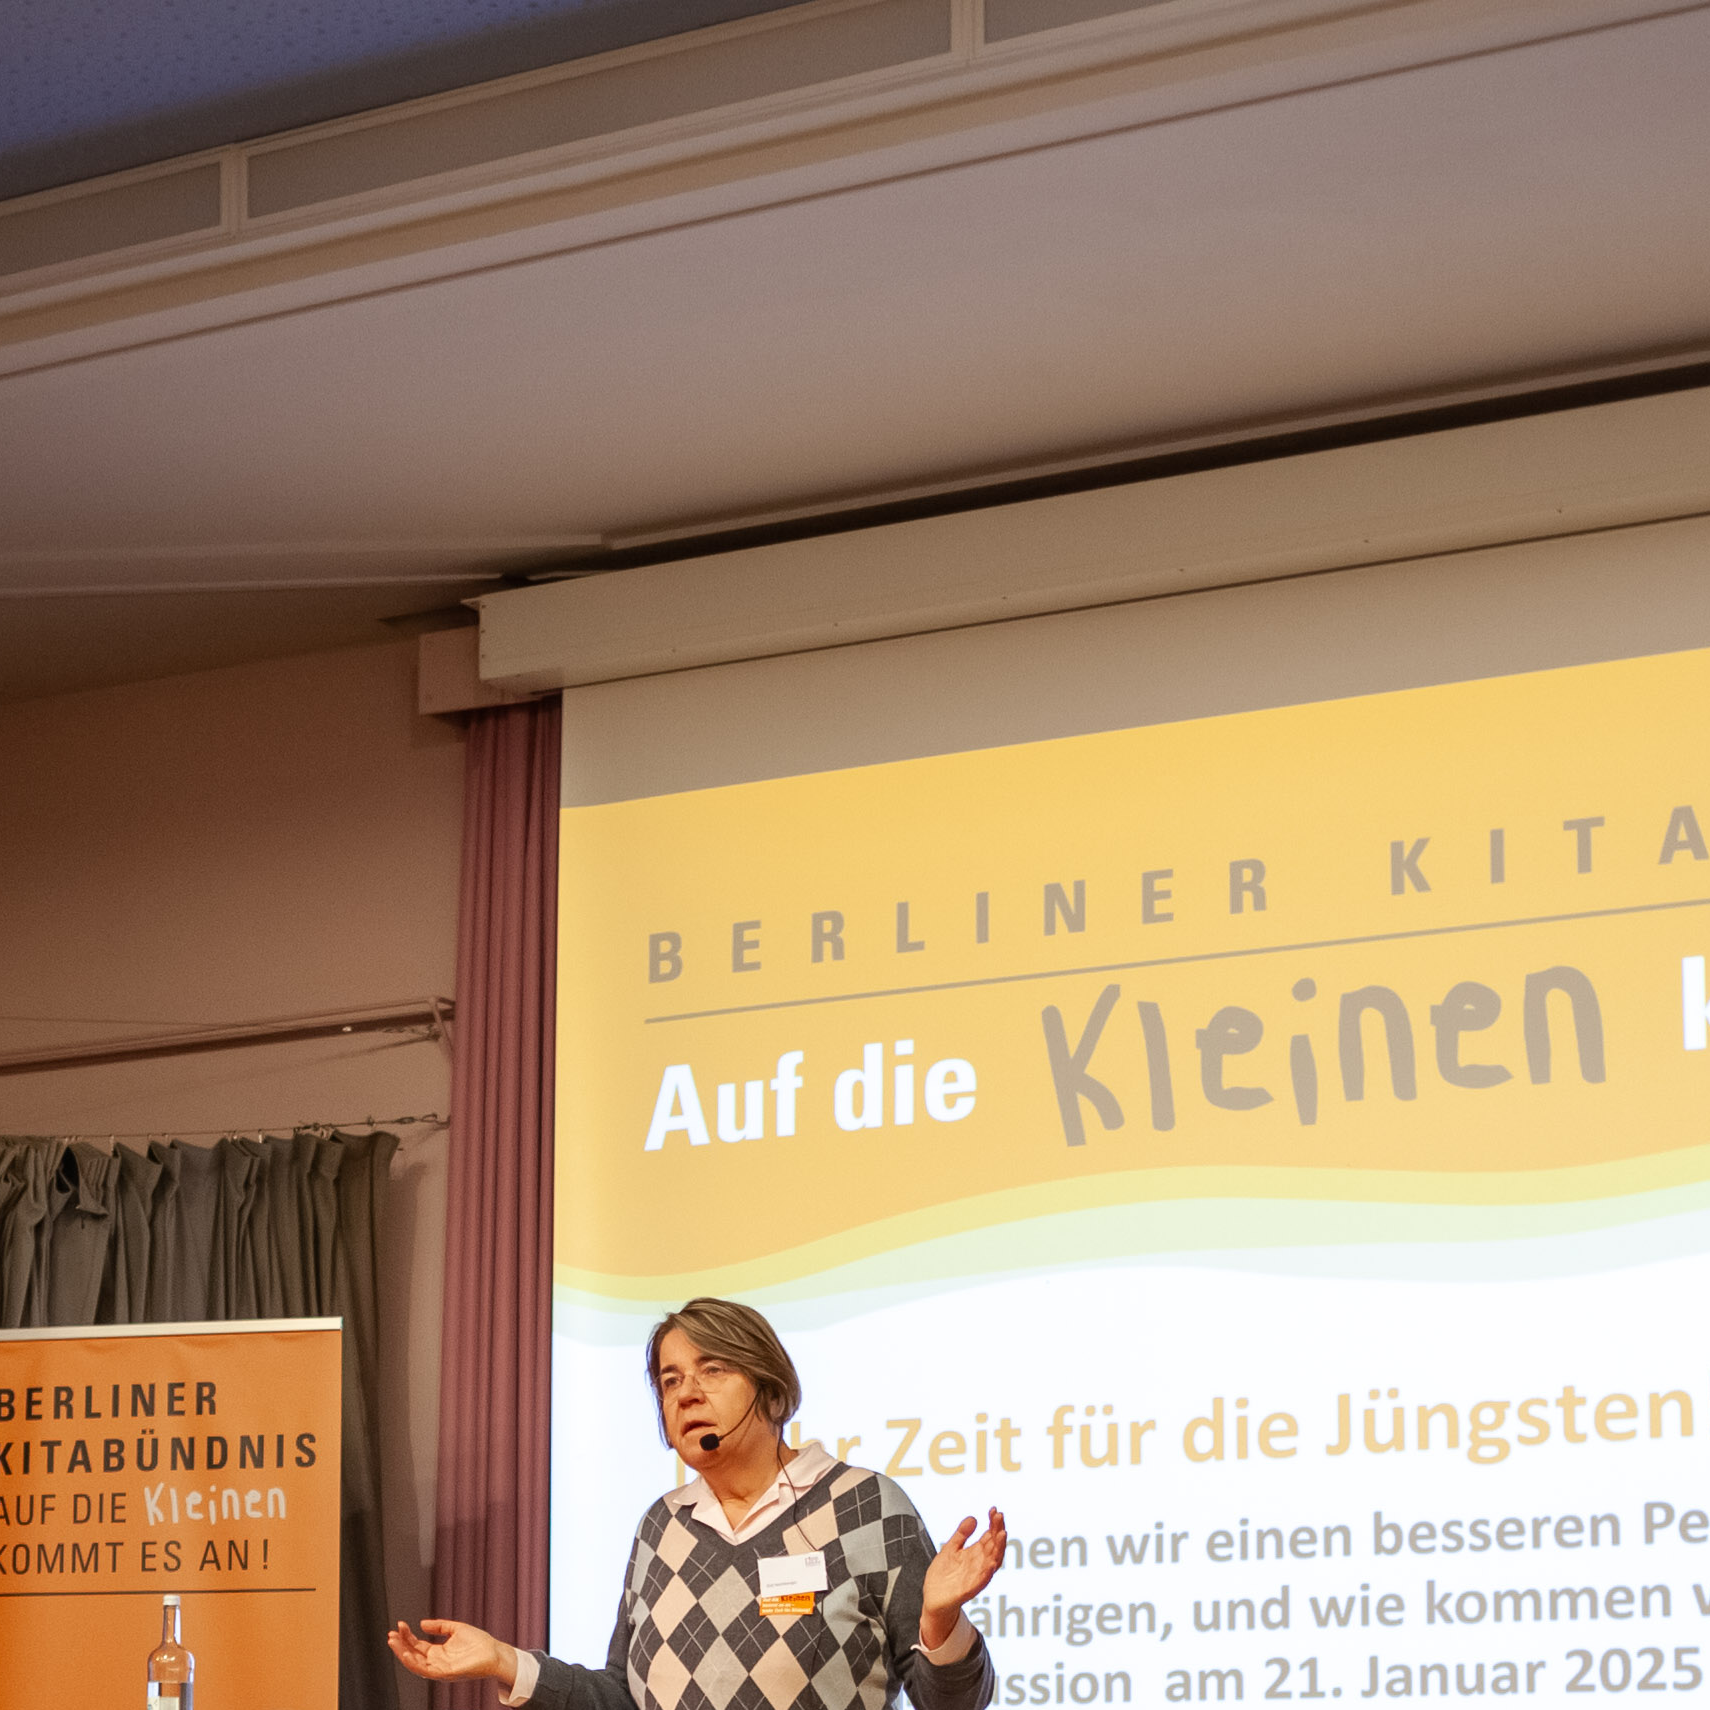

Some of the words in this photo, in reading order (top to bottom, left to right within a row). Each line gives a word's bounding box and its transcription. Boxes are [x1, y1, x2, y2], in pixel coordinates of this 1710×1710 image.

[648, 858, 1268, 984] BERLINER
[643, 1050, 804, 1151] Auf
[834, 1038, 977, 1132] die
[1041, 965, 1607, 1148] Kleinen
[885, 1412, 1022, 1477] Zeit
[1046, 1404, 1154, 1469] für
[1181, 1396, 1296, 1463] die
[73, 1492, 127, 1524] DIE
[144, 1482, 287, 1526] Kleinen
[141, 1540, 182, 1572] ES
[1105, 1521, 1190, 1566] wir
[1206, 1518, 1352, 1562] einen
[1372, 1511, 1621, 1556] besseren
[968, 1593, 1173, 1647] ährigen,
[1193, 1585, 1290, 1632] und
[1310, 1583, 1405, 1628] wie
[1426, 1580, 1671, 1625] kommen
[992, 1662, 1131, 1706] ssion
[1164, 1667, 1245, 1702] am
[1264, 1657, 1343, 1700] 21.
[1361, 1656, 1546, 1699] Januar
[1565, 1647, 1704, 1694] 2025
